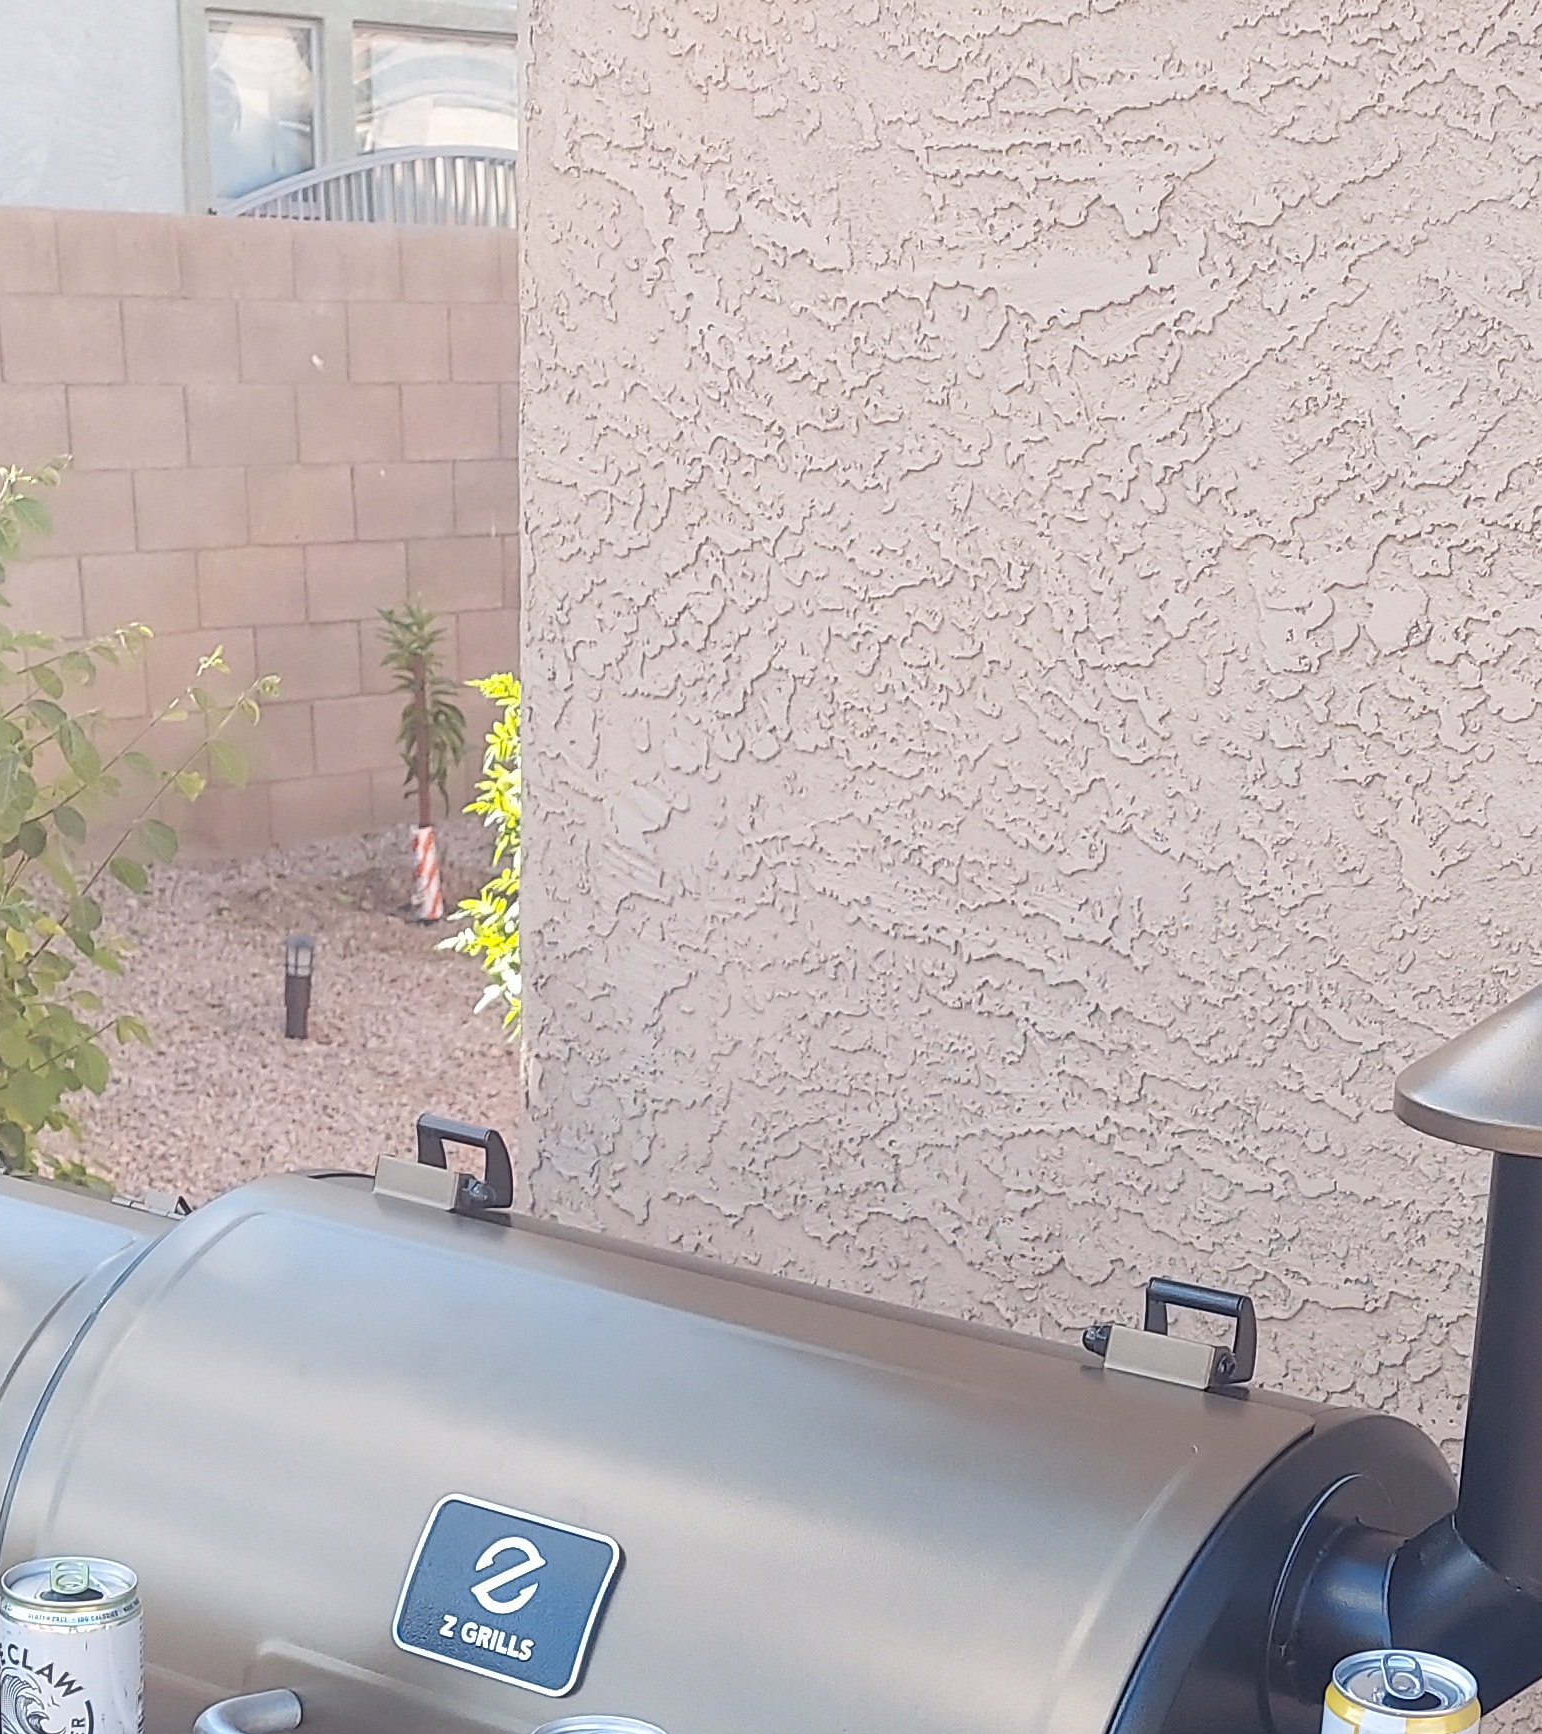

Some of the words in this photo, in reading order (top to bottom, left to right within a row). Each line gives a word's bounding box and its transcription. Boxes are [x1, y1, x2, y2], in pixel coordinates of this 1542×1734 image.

[439, 1614, 458, 1639] Z
[460, 1621, 535, 1662] GRILLS
[7, 1643, 85, 1698] CLAW
